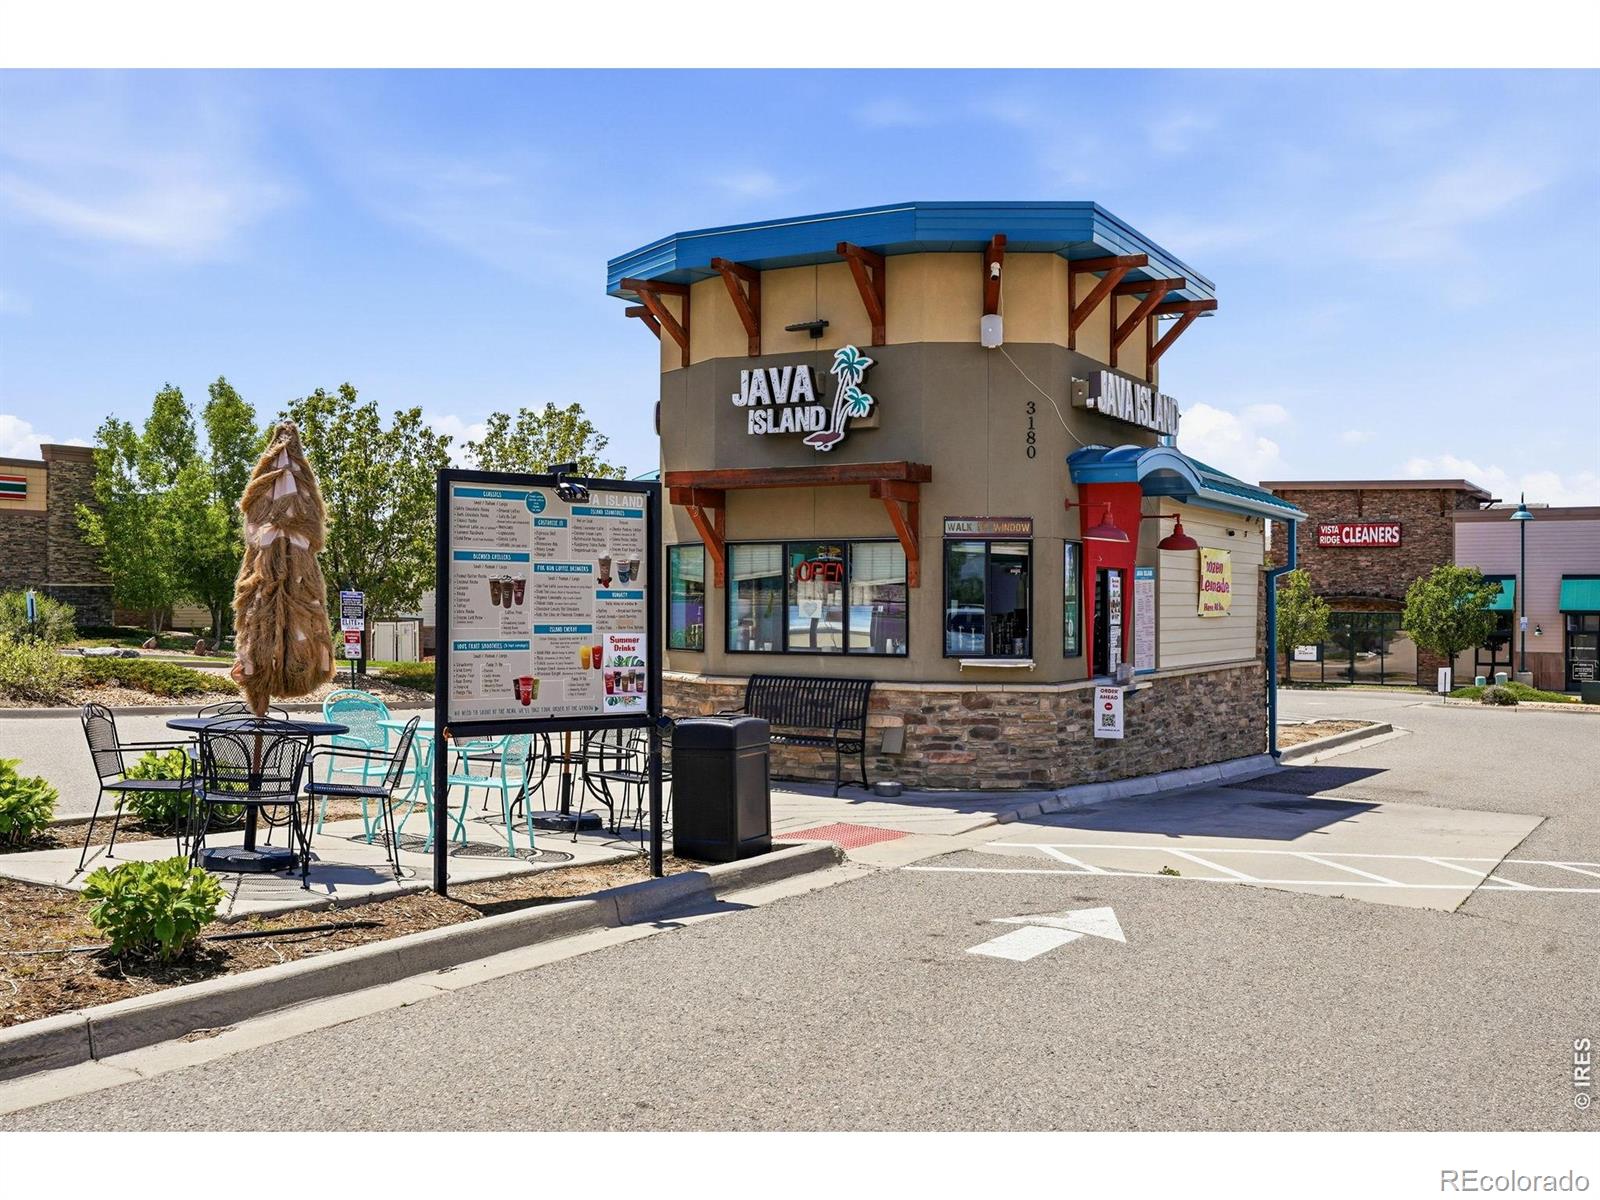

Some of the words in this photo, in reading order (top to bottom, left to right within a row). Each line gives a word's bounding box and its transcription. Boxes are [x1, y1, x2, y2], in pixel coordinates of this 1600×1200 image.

[732, 365, 816, 407] JAVA
[1098, 370, 1134, 423] JAVA
[1134, 384, 1180, 436] ISLAND
[748, 406, 826, 435] ISLAND
[1026, 401, 1036, 459] 3180
[606, 494, 644, 508] ISLAND
[947, 522, 972, 531] WALK
[992, 522, 1030, 532] WINDOW
[1320, 526, 1339, 534] VISTA
[1342, 526, 1400, 543] CLEANERS
[1320, 536, 1340, 544] RIDGE
[797, 560, 844, 582] OPEN
